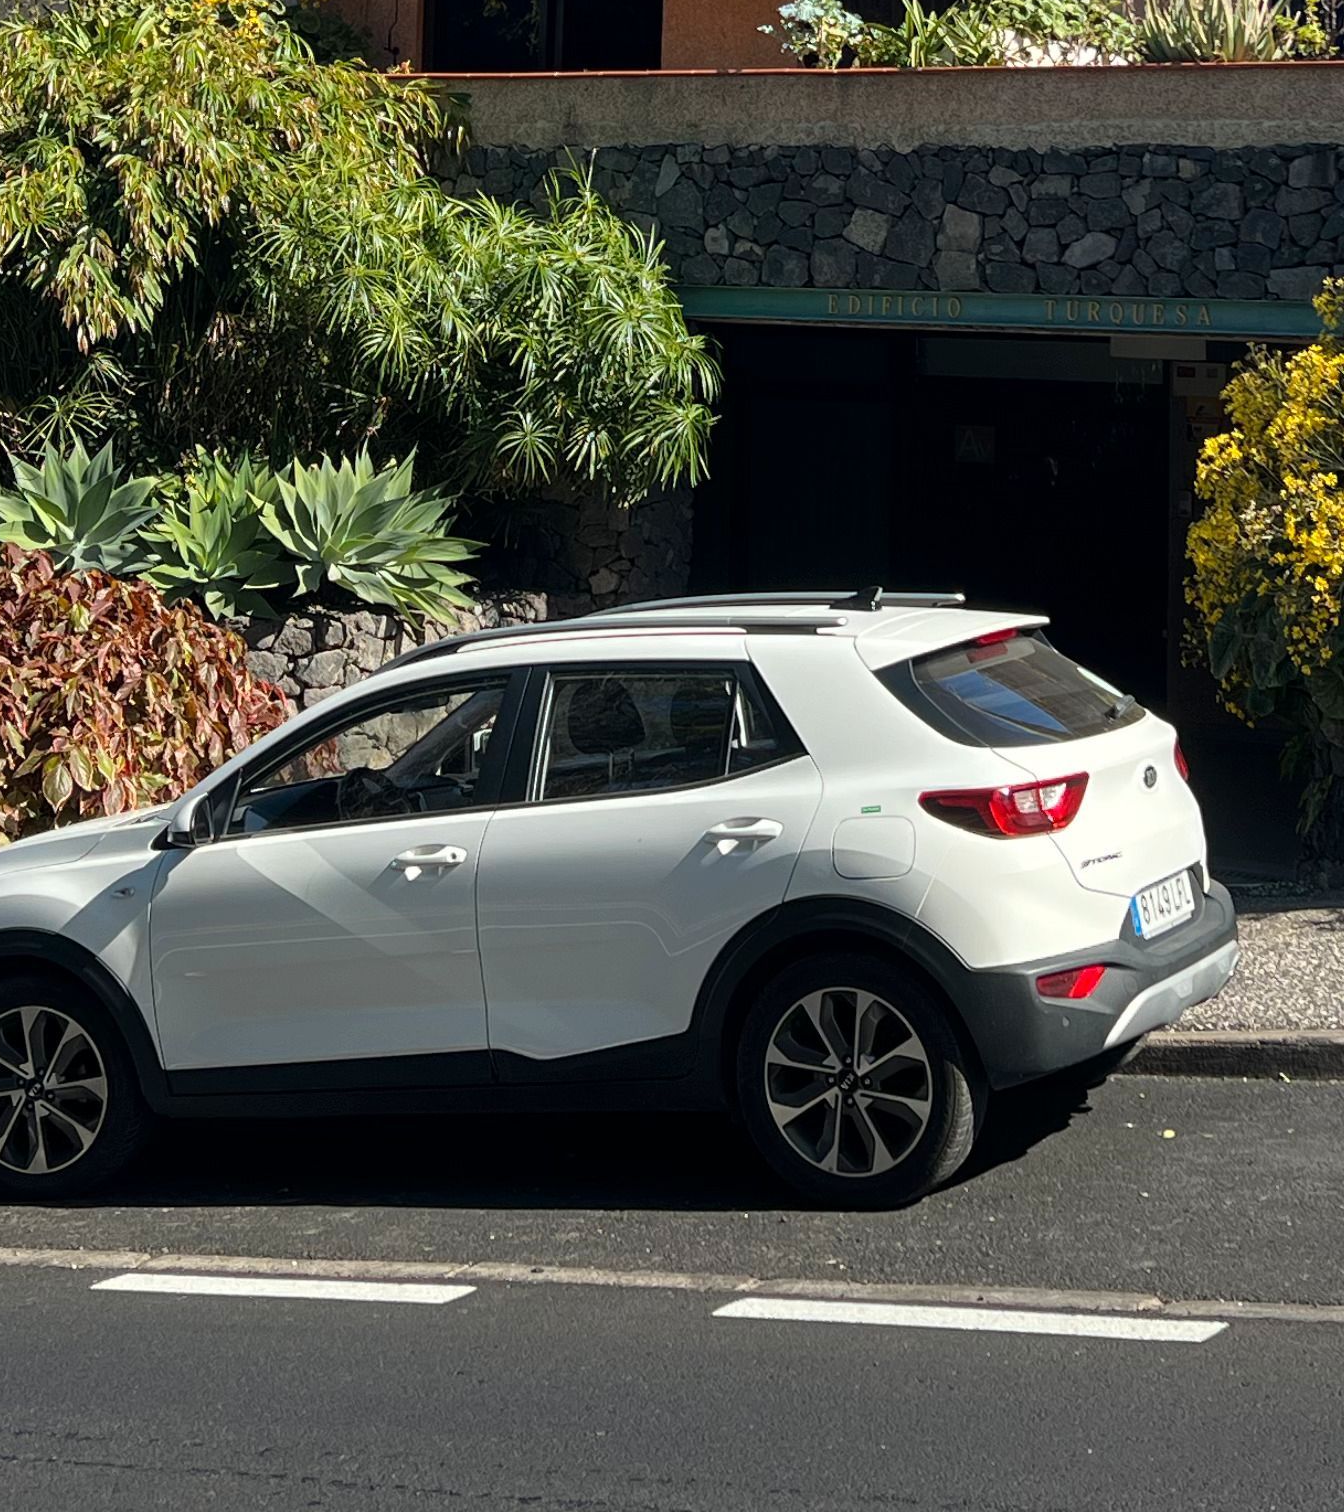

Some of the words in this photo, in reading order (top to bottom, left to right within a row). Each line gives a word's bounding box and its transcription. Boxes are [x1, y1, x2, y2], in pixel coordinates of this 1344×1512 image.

[827, 294, 962, 319] EDIFICIO
[1044, 300, 1211, 326] TURQUESA
[1141, 885, 1171, 925] 8149
[1170, 878, 1191, 911] LFL
